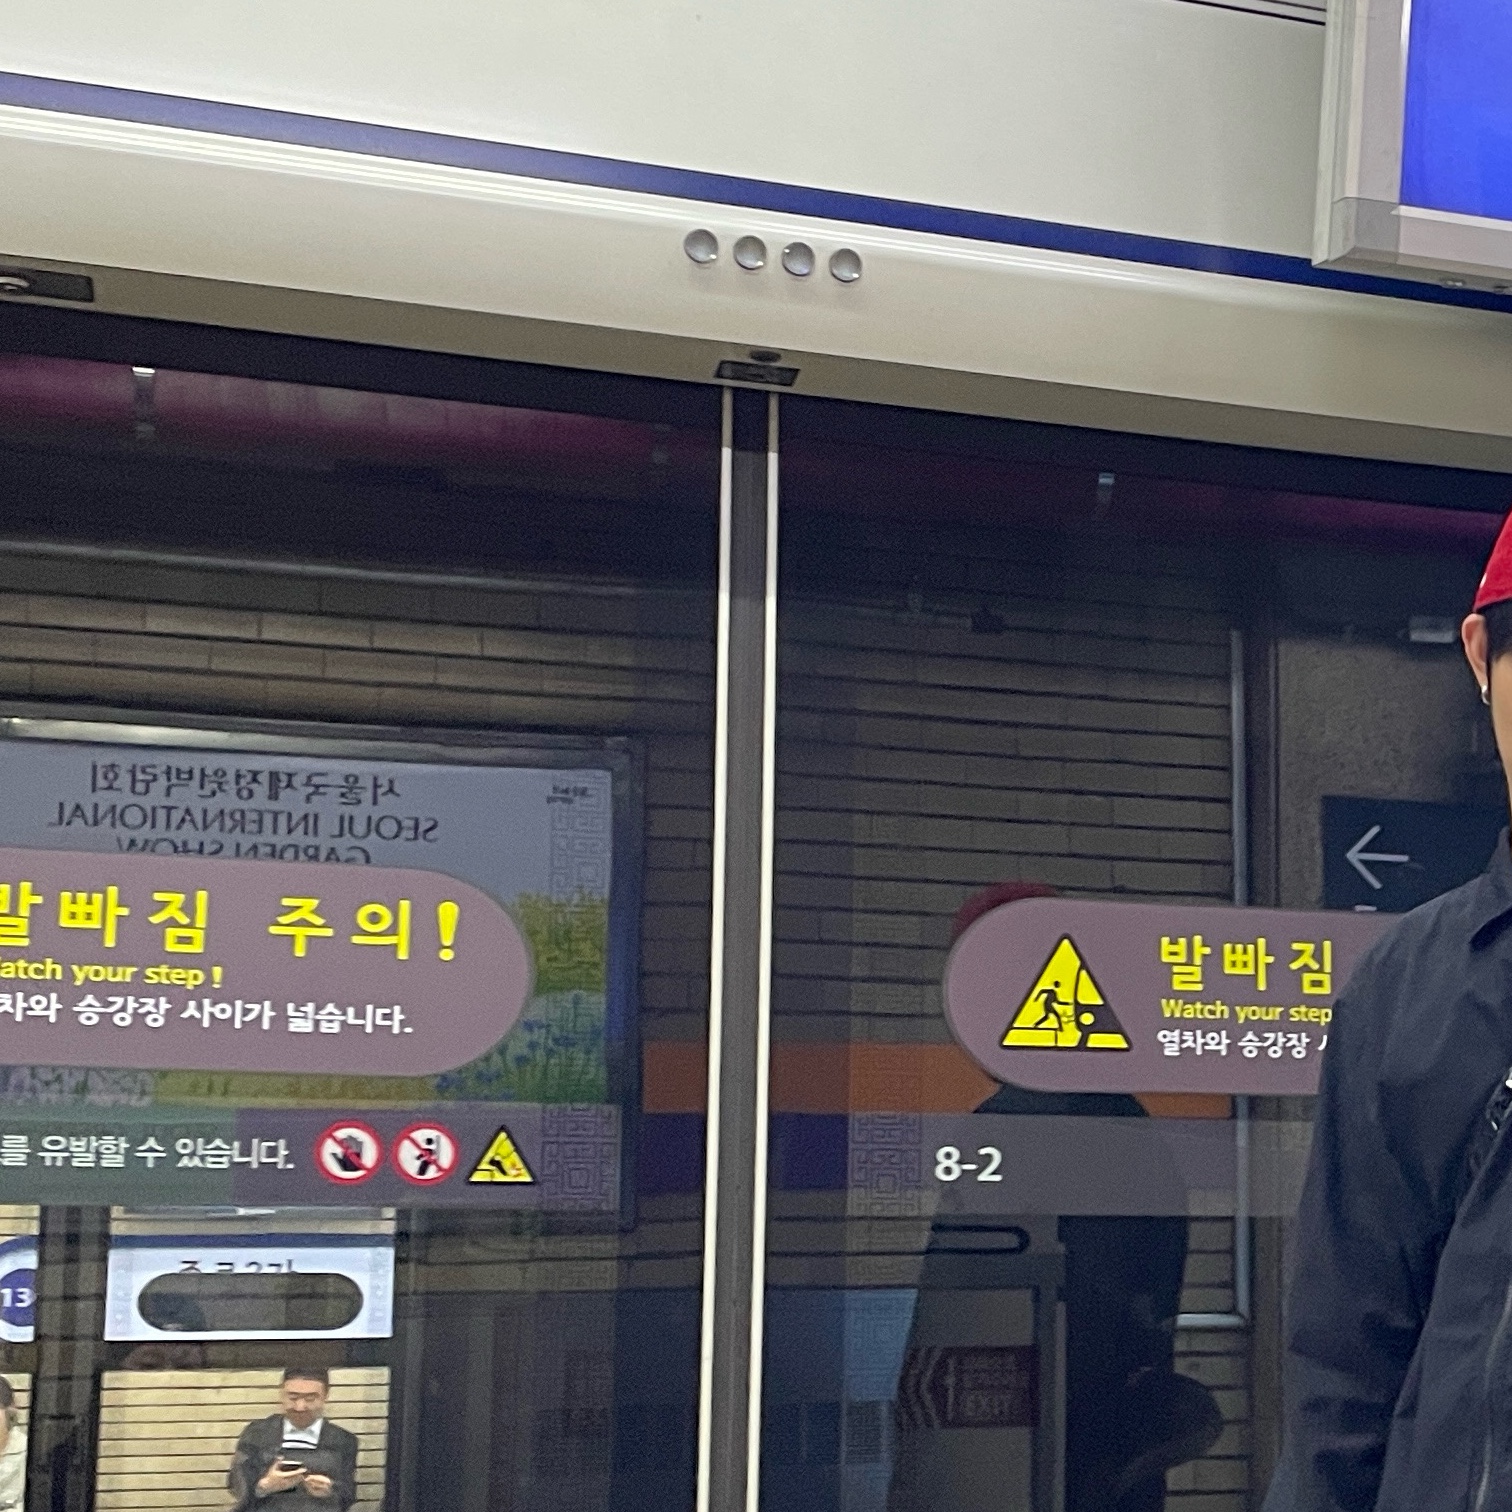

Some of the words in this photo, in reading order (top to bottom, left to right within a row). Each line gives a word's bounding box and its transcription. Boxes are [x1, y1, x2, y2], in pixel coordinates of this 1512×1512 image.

[0, 957, 63, 981] atch
[71, 965, 138, 986] your
[72, 994, 172, 1028] 승강장
[180, 997, 277, 1030] 사이가
[286, 1002, 413, 1034] 넓습니다.
[1161, 998, 1230, 1020] Watch
[1235, 1005, 1284, 1024] your
[1289, 1004, 1333, 1026] step
[1157, 1029, 1231, 1056] 열차와
[1237, 1031, 1311, 1059] 승강장
[37, 1135, 130, 1168] 유발할
[134, 1137, 167, 1168] 수
[175, 1138, 295, 1169] 있습니다.
[933, 1145, 1003, 1183] 8-2
